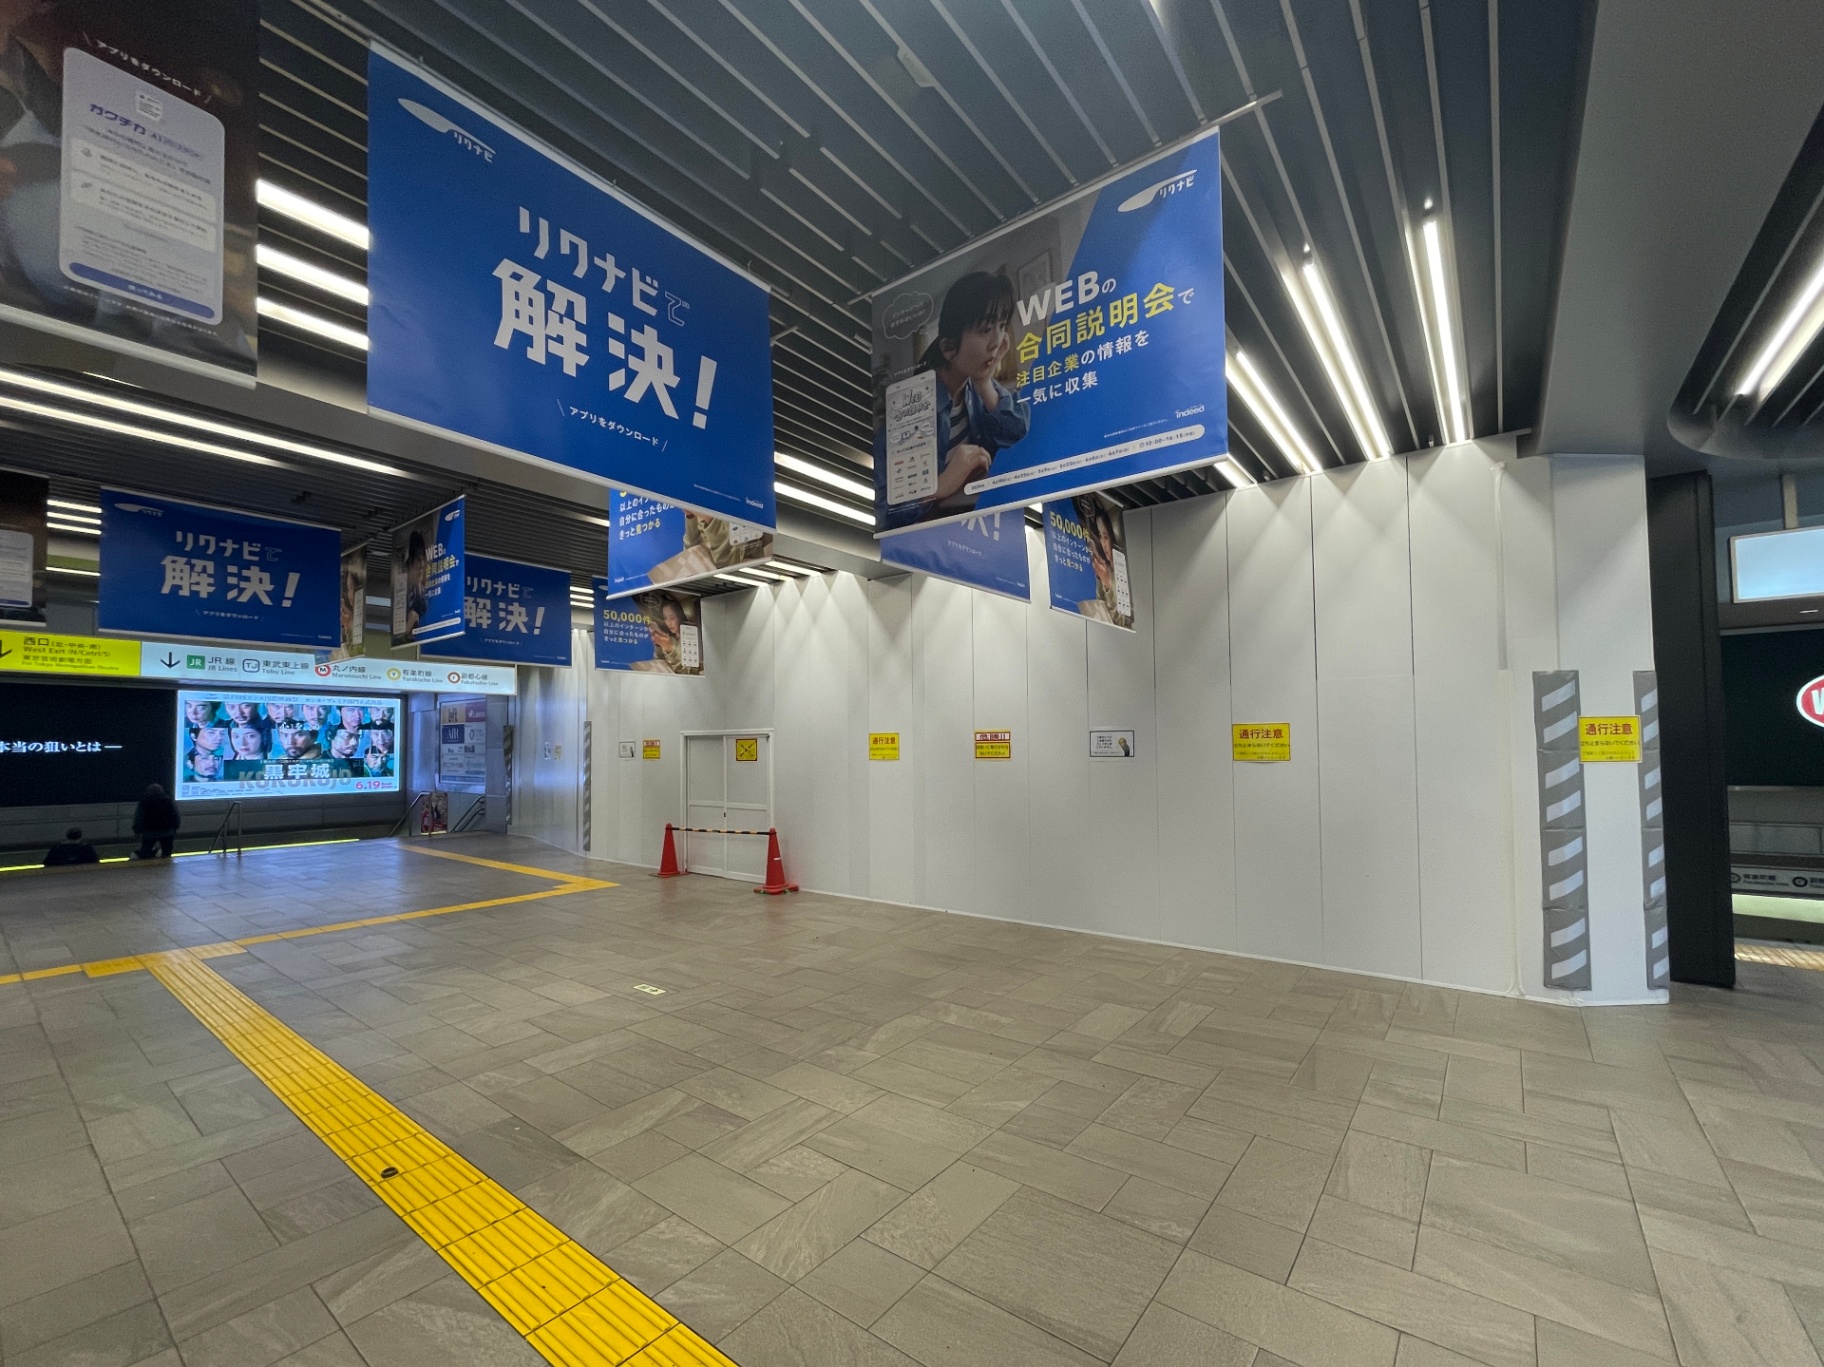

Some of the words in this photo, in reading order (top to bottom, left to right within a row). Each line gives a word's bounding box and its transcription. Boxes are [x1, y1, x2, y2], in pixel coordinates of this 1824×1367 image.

[96, 39, 201, 97] アプリをダウンロード
[89, 103, 147, 136] ガクチカ
[453, 131, 494, 164] リクナビ
[1159, 175, 1195, 199] リクナビ
[519, 205, 690, 327] リクナビで
[1016, 270, 1117, 326] WEBの
[1016, 282, 1195, 365] 合同説明会で
[492, 258, 717, 430] 解決!
[1016, 330, 1150, 388] 注目企業の情報を
[1016, 370, 1098, 405] 一気に収集
[1175, 404, 1205, 418] indeed
[569, 406, 659, 447] アプリをダウンロード
[619, 518, 661, 540] きっと見つかる
[1049, 511, 1091, 541] 50,000件
[176, 531, 282, 562] リクナビで
[161, 555, 300, 608] 解決!
[467, 576, 534, 599] リクナビで
[464, 596, 545, 635] 解決!
[603, 609, 651, 624] 50,000件
[23, 646, 47, 654] West
[49, 647, 66, 655] Exit
[208, 656, 222, 665] JR
[225, 657, 235, 665] 線
[190, 659, 202, 667] JR
[262, 660, 310, 670] 東武東上線
[333, 665, 366, 673] 丸ノ内線
[402, 669, 432, 677] 有楽町線
[1239, 728, 1284, 740] 通行注意
[1585, 722, 1633, 736] 通行注意
[264, 764, 330, 780] 黒牢城
[355, 780, 380, 790] 6.19
